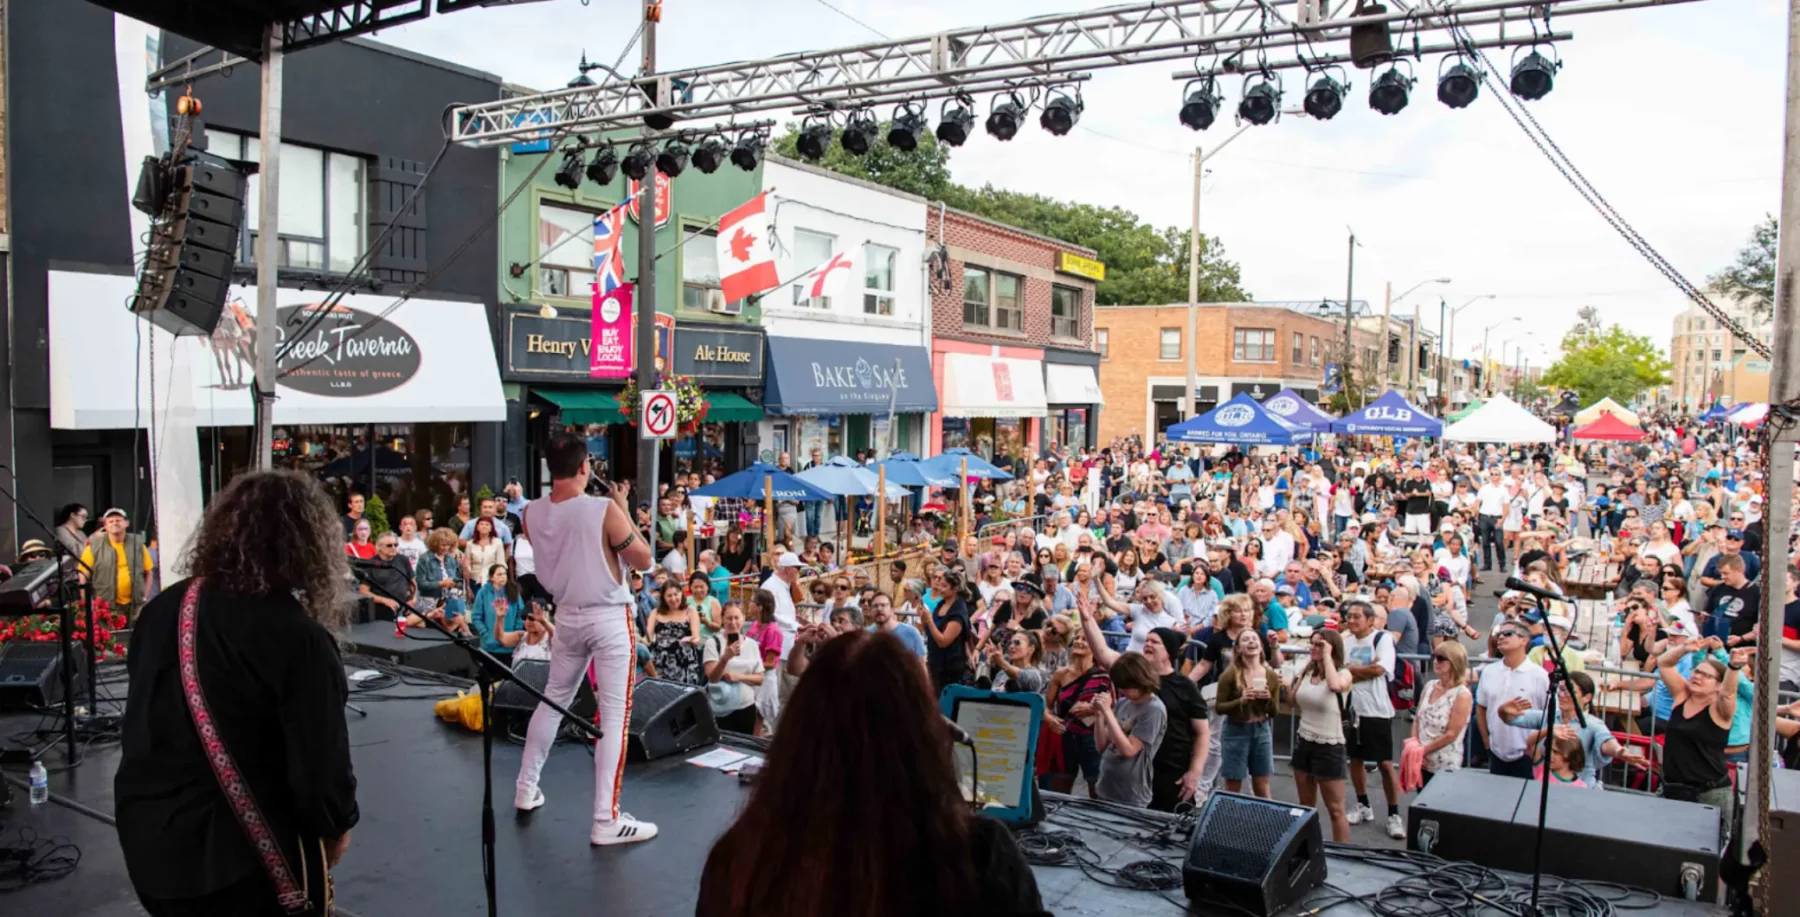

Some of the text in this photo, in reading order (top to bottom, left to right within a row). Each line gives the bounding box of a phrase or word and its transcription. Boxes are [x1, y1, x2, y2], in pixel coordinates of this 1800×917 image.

[602, 328, 619, 336] BUY
[330, 324, 413, 361] Taverna
[602, 336, 619, 345] EAT
[526, 334, 577, 359] Henry
[597, 344, 624, 353] ENJOY
[597, 353, 625, 362] LOCAL
[694, 344, 751, 362] Ale House
[333, 369, 356, 378] taste
[360, 369, 369, 378] of
[811, 362, 857, 388] BAKE
[851, 392, 861, 400] the
[1364, 406, 1412, 421] GLB
[1239, 432, 1267, 440] ONTARIO
[760, 488, 807, 498] RONI
